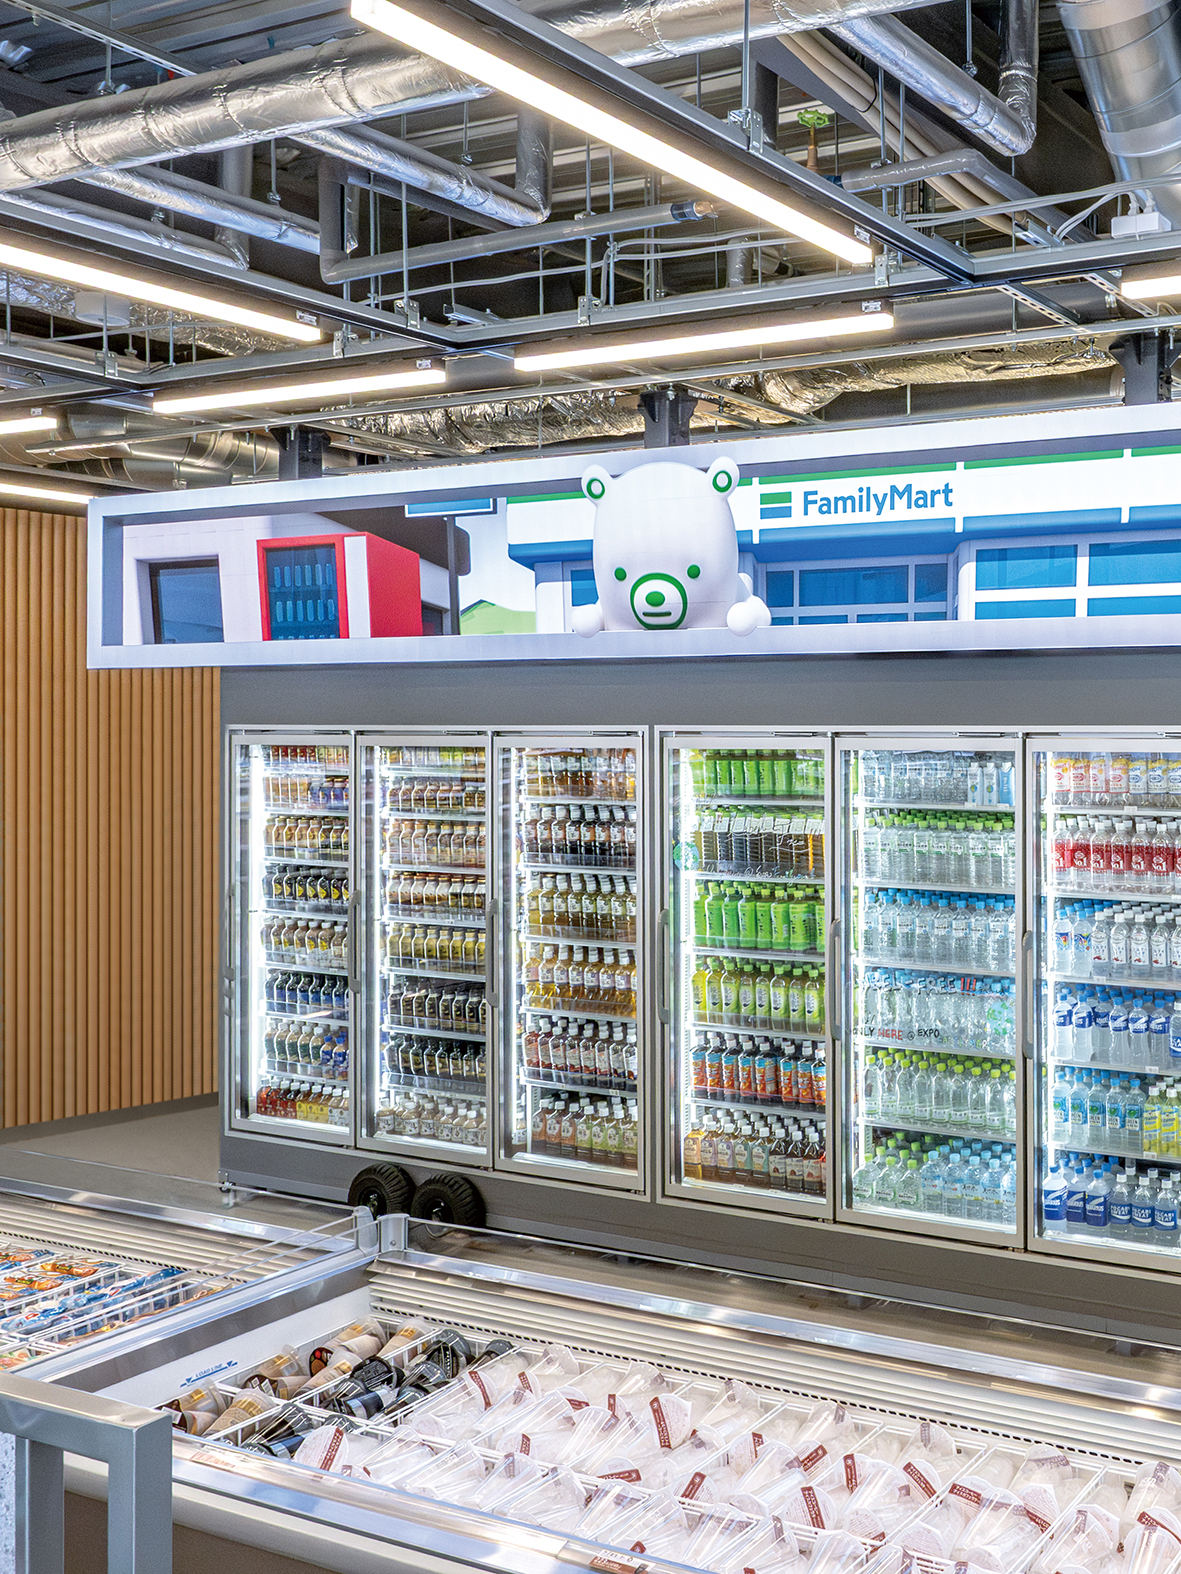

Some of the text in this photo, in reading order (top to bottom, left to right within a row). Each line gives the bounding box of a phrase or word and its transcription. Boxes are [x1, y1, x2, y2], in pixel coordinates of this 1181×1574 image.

[803, 482, 953, 516] FamilyMart
[878, 1028, 903, 1041] HERE
[917, 1028, 940, 1039] EXPO
[196, 1363, 223, 1378] LOAD LINE
